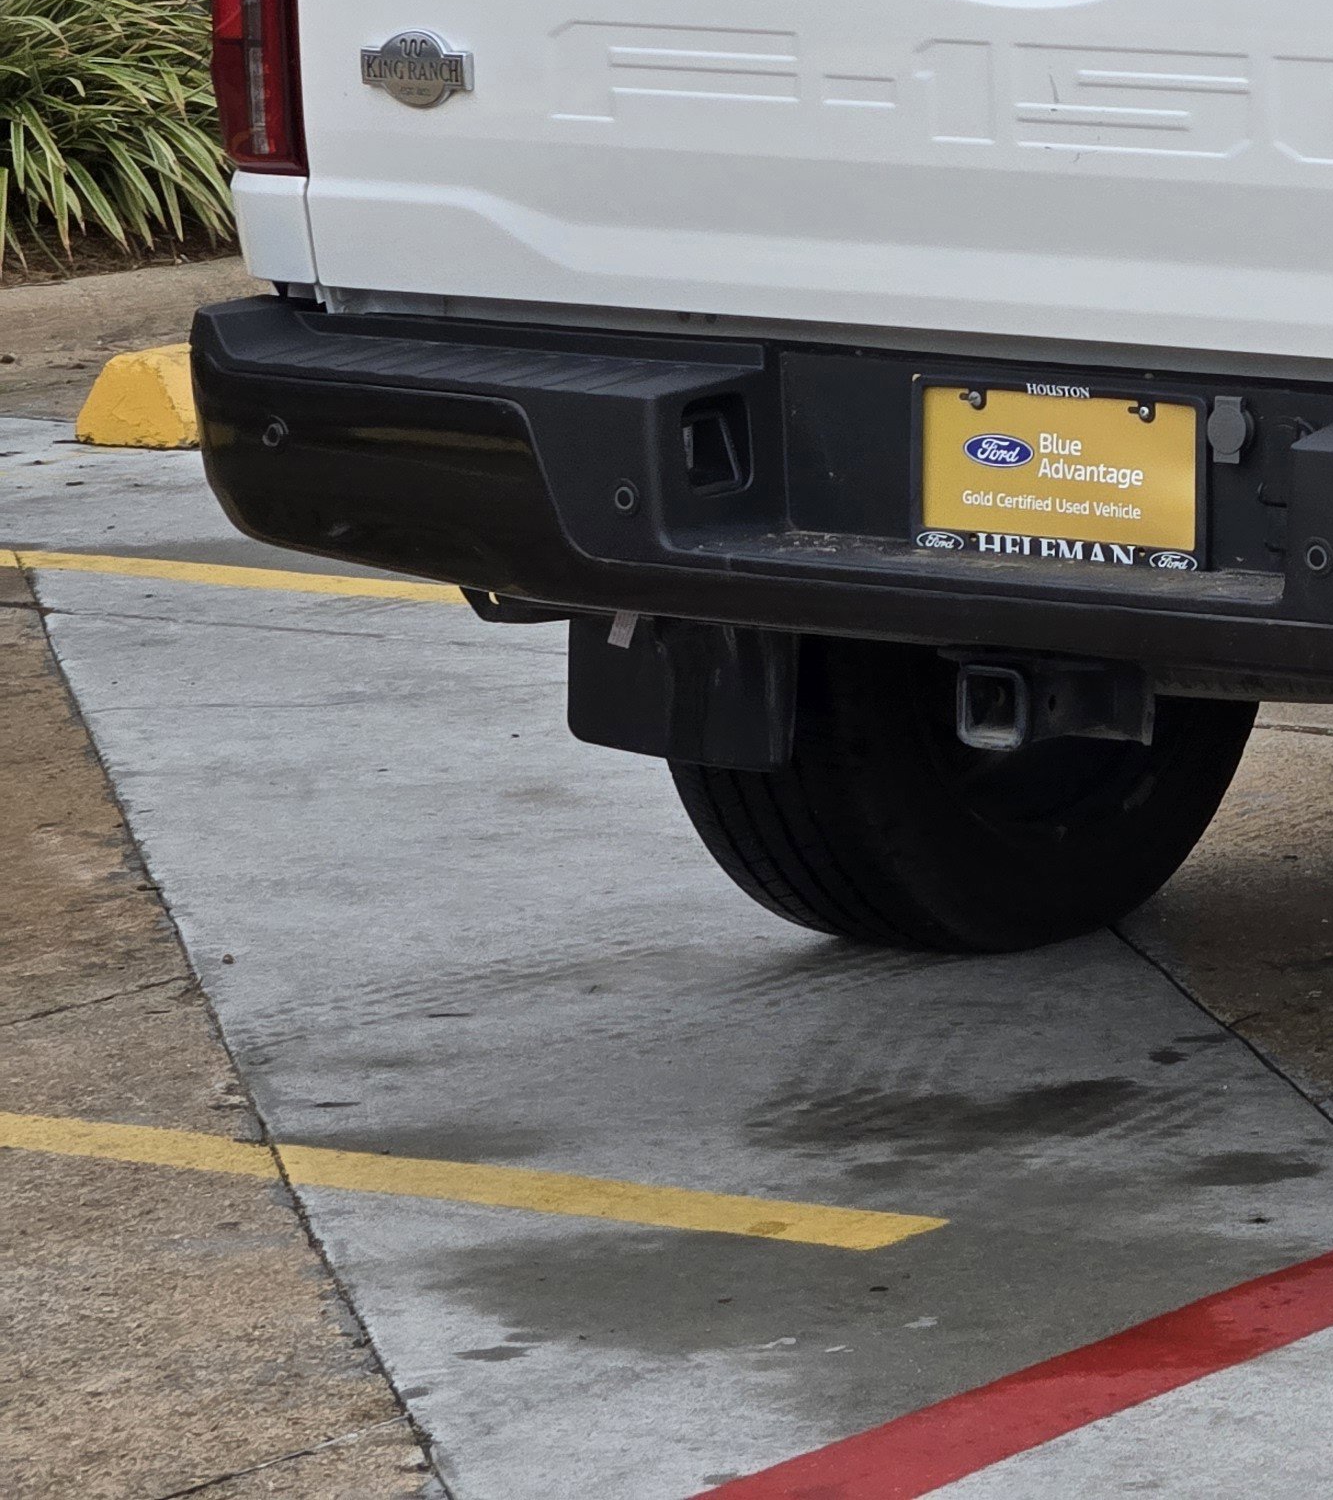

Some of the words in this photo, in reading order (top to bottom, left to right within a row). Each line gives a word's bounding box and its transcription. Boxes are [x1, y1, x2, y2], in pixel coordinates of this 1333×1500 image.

[365, 56, 404, 80] KING
[408, 58, 460, 83] RANCH
[1026, 382, 1090, 399] HOUSTON
[976, 438, 1021, 463] Ford
[1039, 433, 1082, 456] Blue
[1038, 457, 1144, 489] Advantage
[962, 490, 993, 507] Gold
[996, 493, 1052, 512] Certified
[1056, 498, 1090, 515] Used
[1093, 501, 1142, 520] Vehicle
[924, 534, 955, 549] Ford
[1157, 553, 1190, 570] Ford
